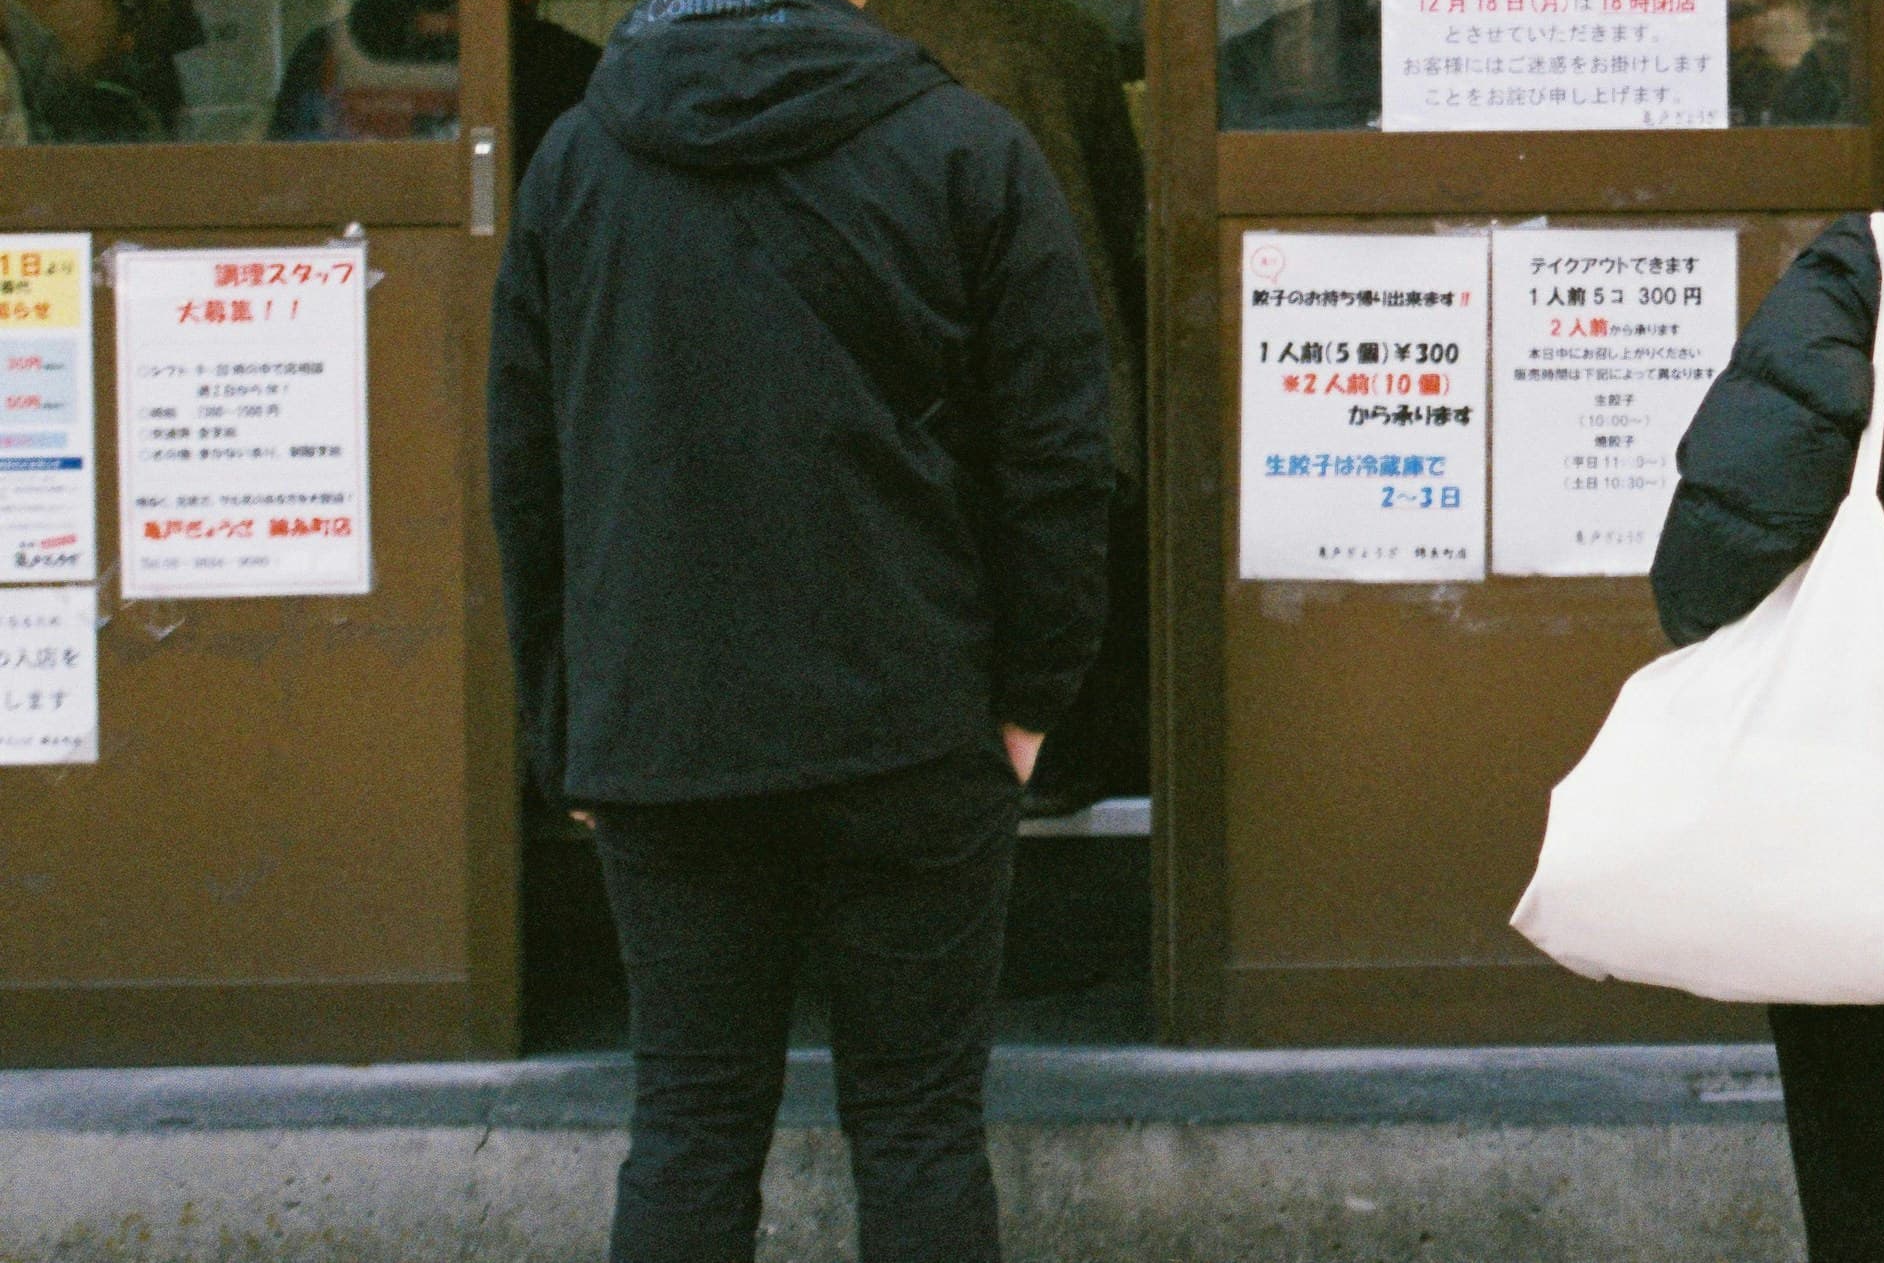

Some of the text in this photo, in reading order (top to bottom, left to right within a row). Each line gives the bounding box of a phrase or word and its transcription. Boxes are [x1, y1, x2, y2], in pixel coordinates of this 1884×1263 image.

[1444, 24, 1660, 44] とさせていただきます。
[1402, 55, 1711, 76] お客様にはご迷惑をお掛けします
[1425, 86, 1682, 107] ことをお詫び申し上げます。
[215, 263, 353, 286] 調理スタッフ
[1530, 256, 1700, 275] テイクアウトできます
[1348, 404, 1471, 425] から承ります
[1265, 454, 1445, 477] 生餃子は冷蔵庫で
